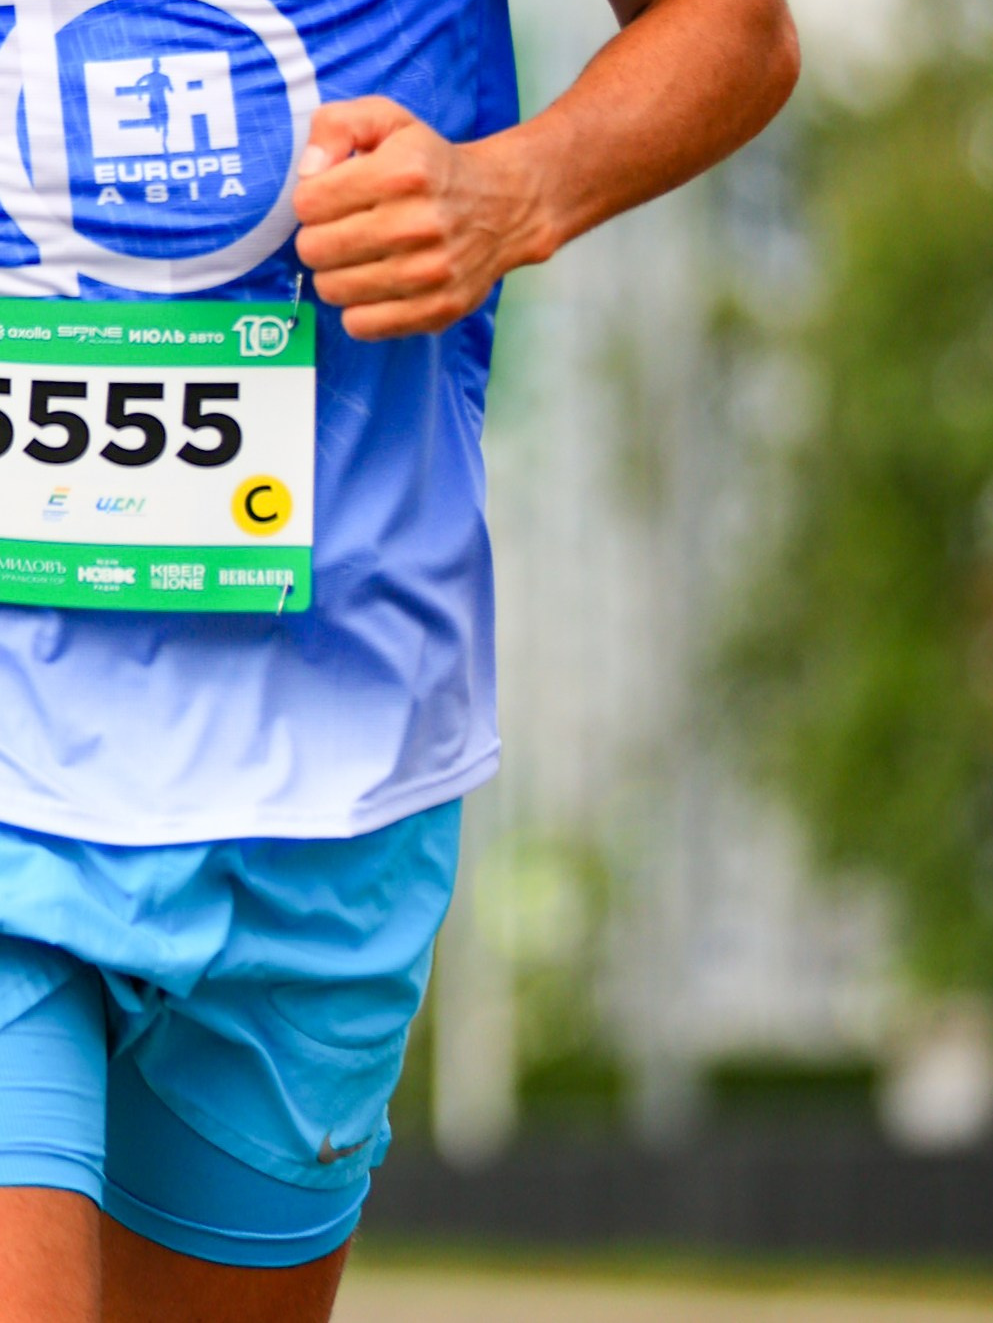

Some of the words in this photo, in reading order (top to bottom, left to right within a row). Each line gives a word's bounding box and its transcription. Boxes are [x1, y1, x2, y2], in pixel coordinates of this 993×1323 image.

[93, 154, 243, 185] EUROPE
[8, 326, 52, 340] axolla
[128, 329, 185, 344] ИЮЛЬ
[188, 331, 225, 344] авто
